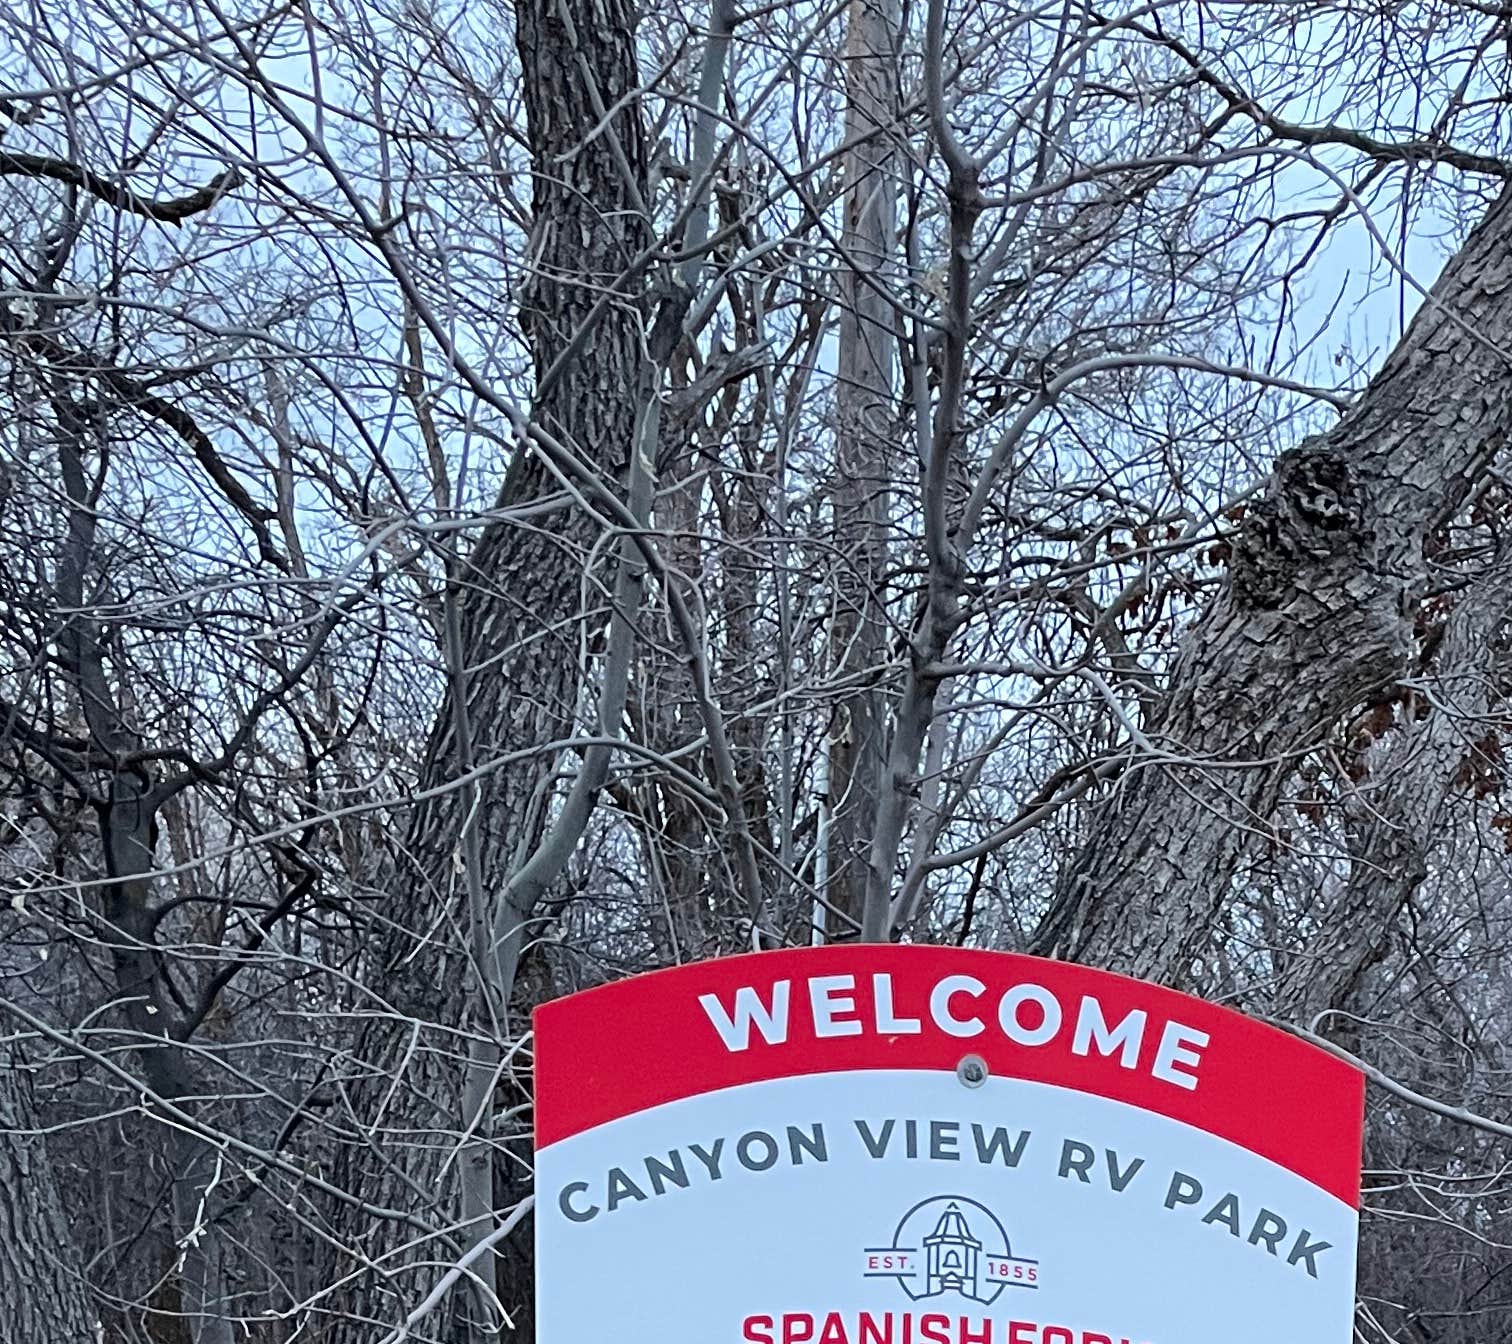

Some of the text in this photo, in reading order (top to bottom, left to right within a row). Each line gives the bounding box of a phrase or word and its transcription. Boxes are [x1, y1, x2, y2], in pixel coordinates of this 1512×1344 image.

[699, 973, 1211, 1091] WELCOME
[558, 1120, 1333, 1279] CANYON VIEW RV PARK
[869, 1256, 914, 1269] EST.
[989, 1262, 1036, 1281] 1855
